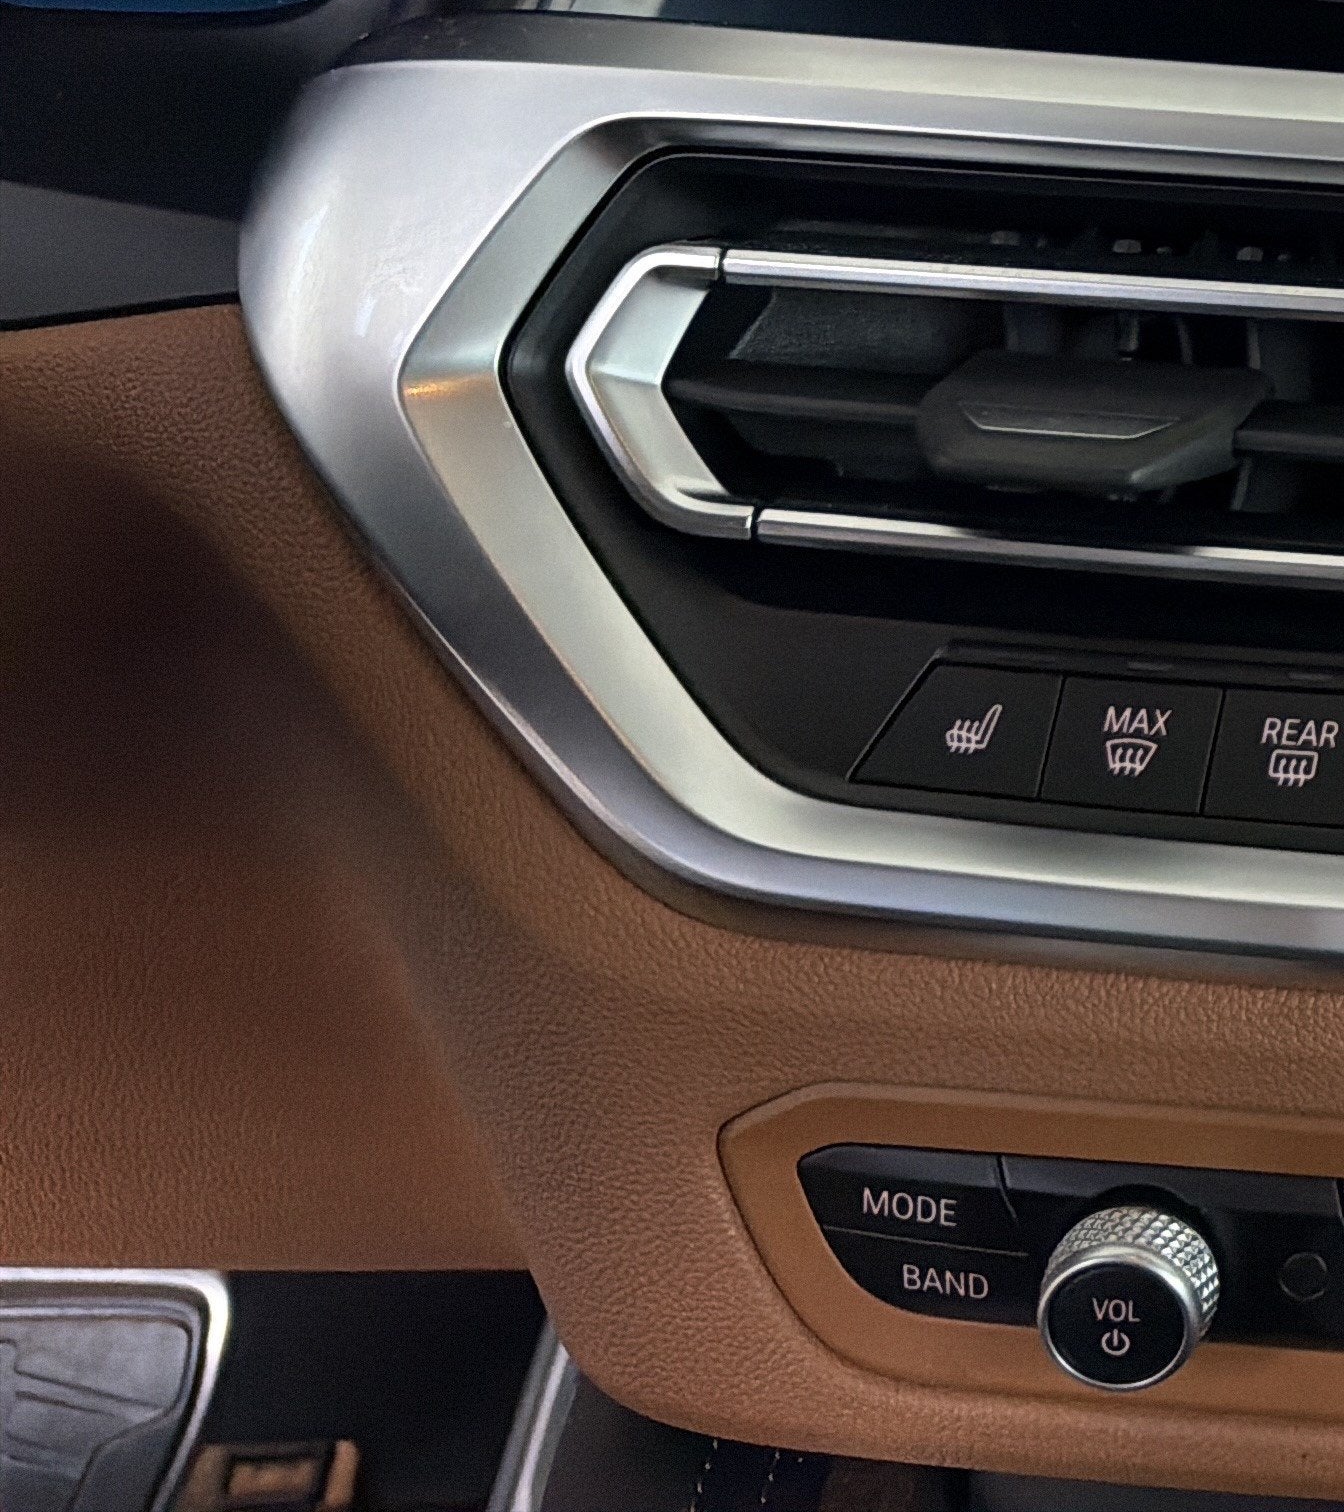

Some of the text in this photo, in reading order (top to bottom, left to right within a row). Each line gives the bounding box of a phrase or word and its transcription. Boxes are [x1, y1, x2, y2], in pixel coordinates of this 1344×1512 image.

[1103, 705, 1172, 737] MAX
[1260, 717, 1339, 749] REAR
[862, 1188, 958, 1226] MODE
[902, 1264, 989, 1299] BAND
[1092, 1298, 1140, 1323] VOL
